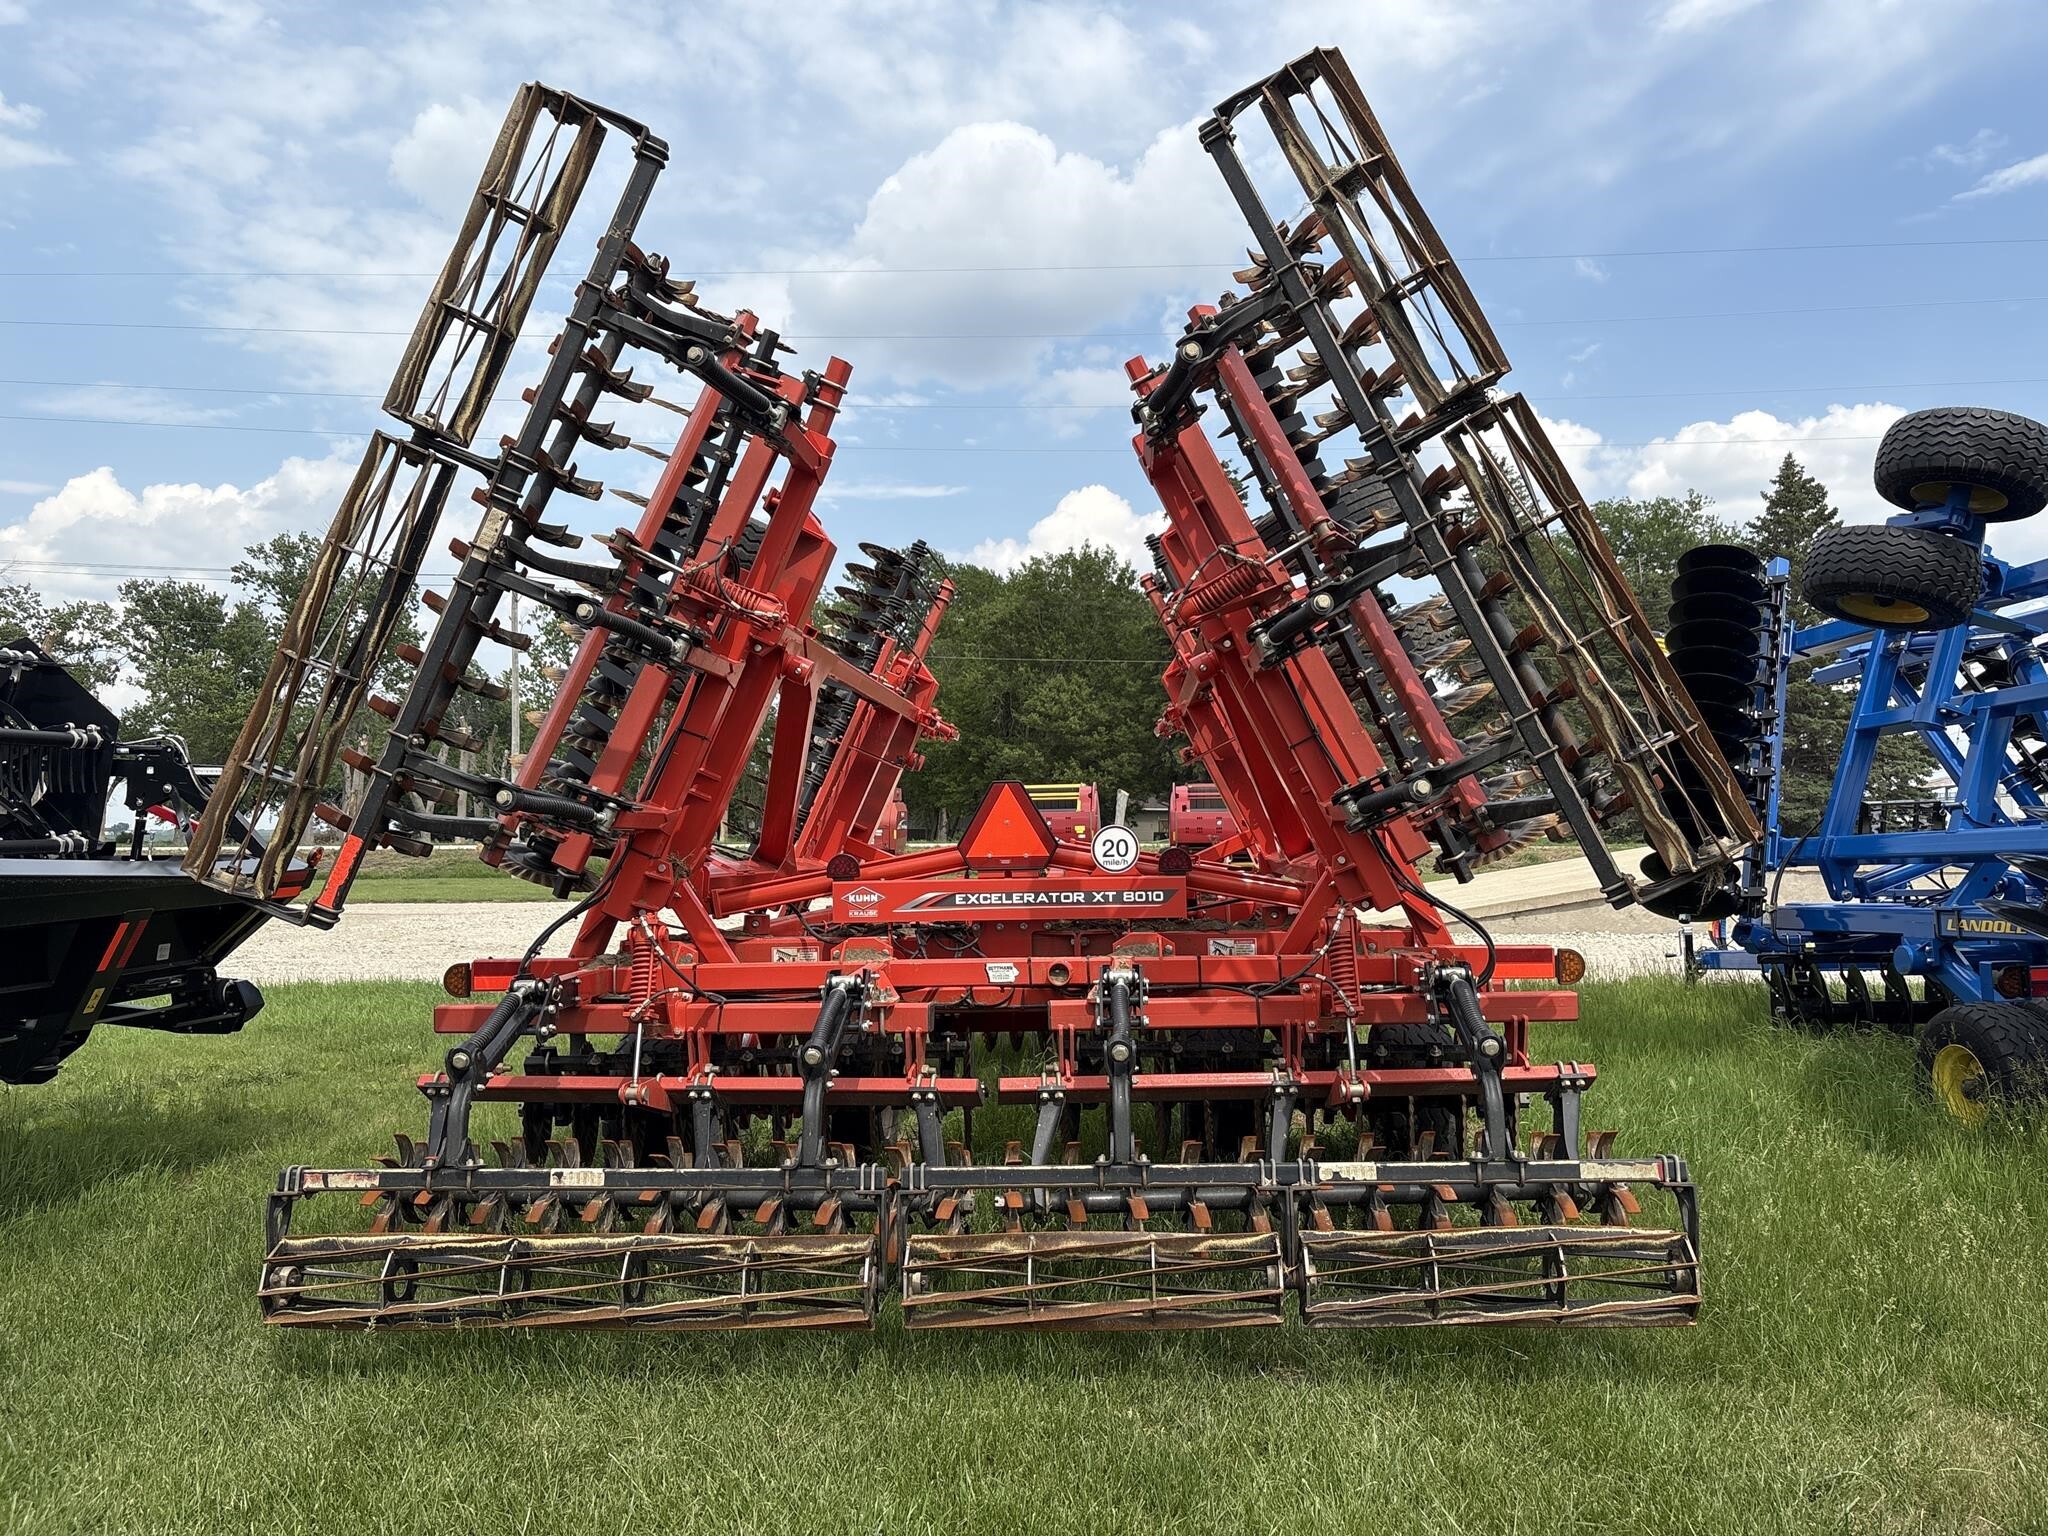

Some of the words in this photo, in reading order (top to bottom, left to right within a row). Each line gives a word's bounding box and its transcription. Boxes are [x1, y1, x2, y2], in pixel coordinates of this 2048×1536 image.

[1102, 838, 1129, 858] 20
[1102, 858, 1129, 866] mile/h
[848, 894, 879, 902] KUHN
[955, 892, 1085, 905] EXCELERATOR
[1092, 891, 1117, 902] XT
[1122, 891, 1164, 902] 8010
